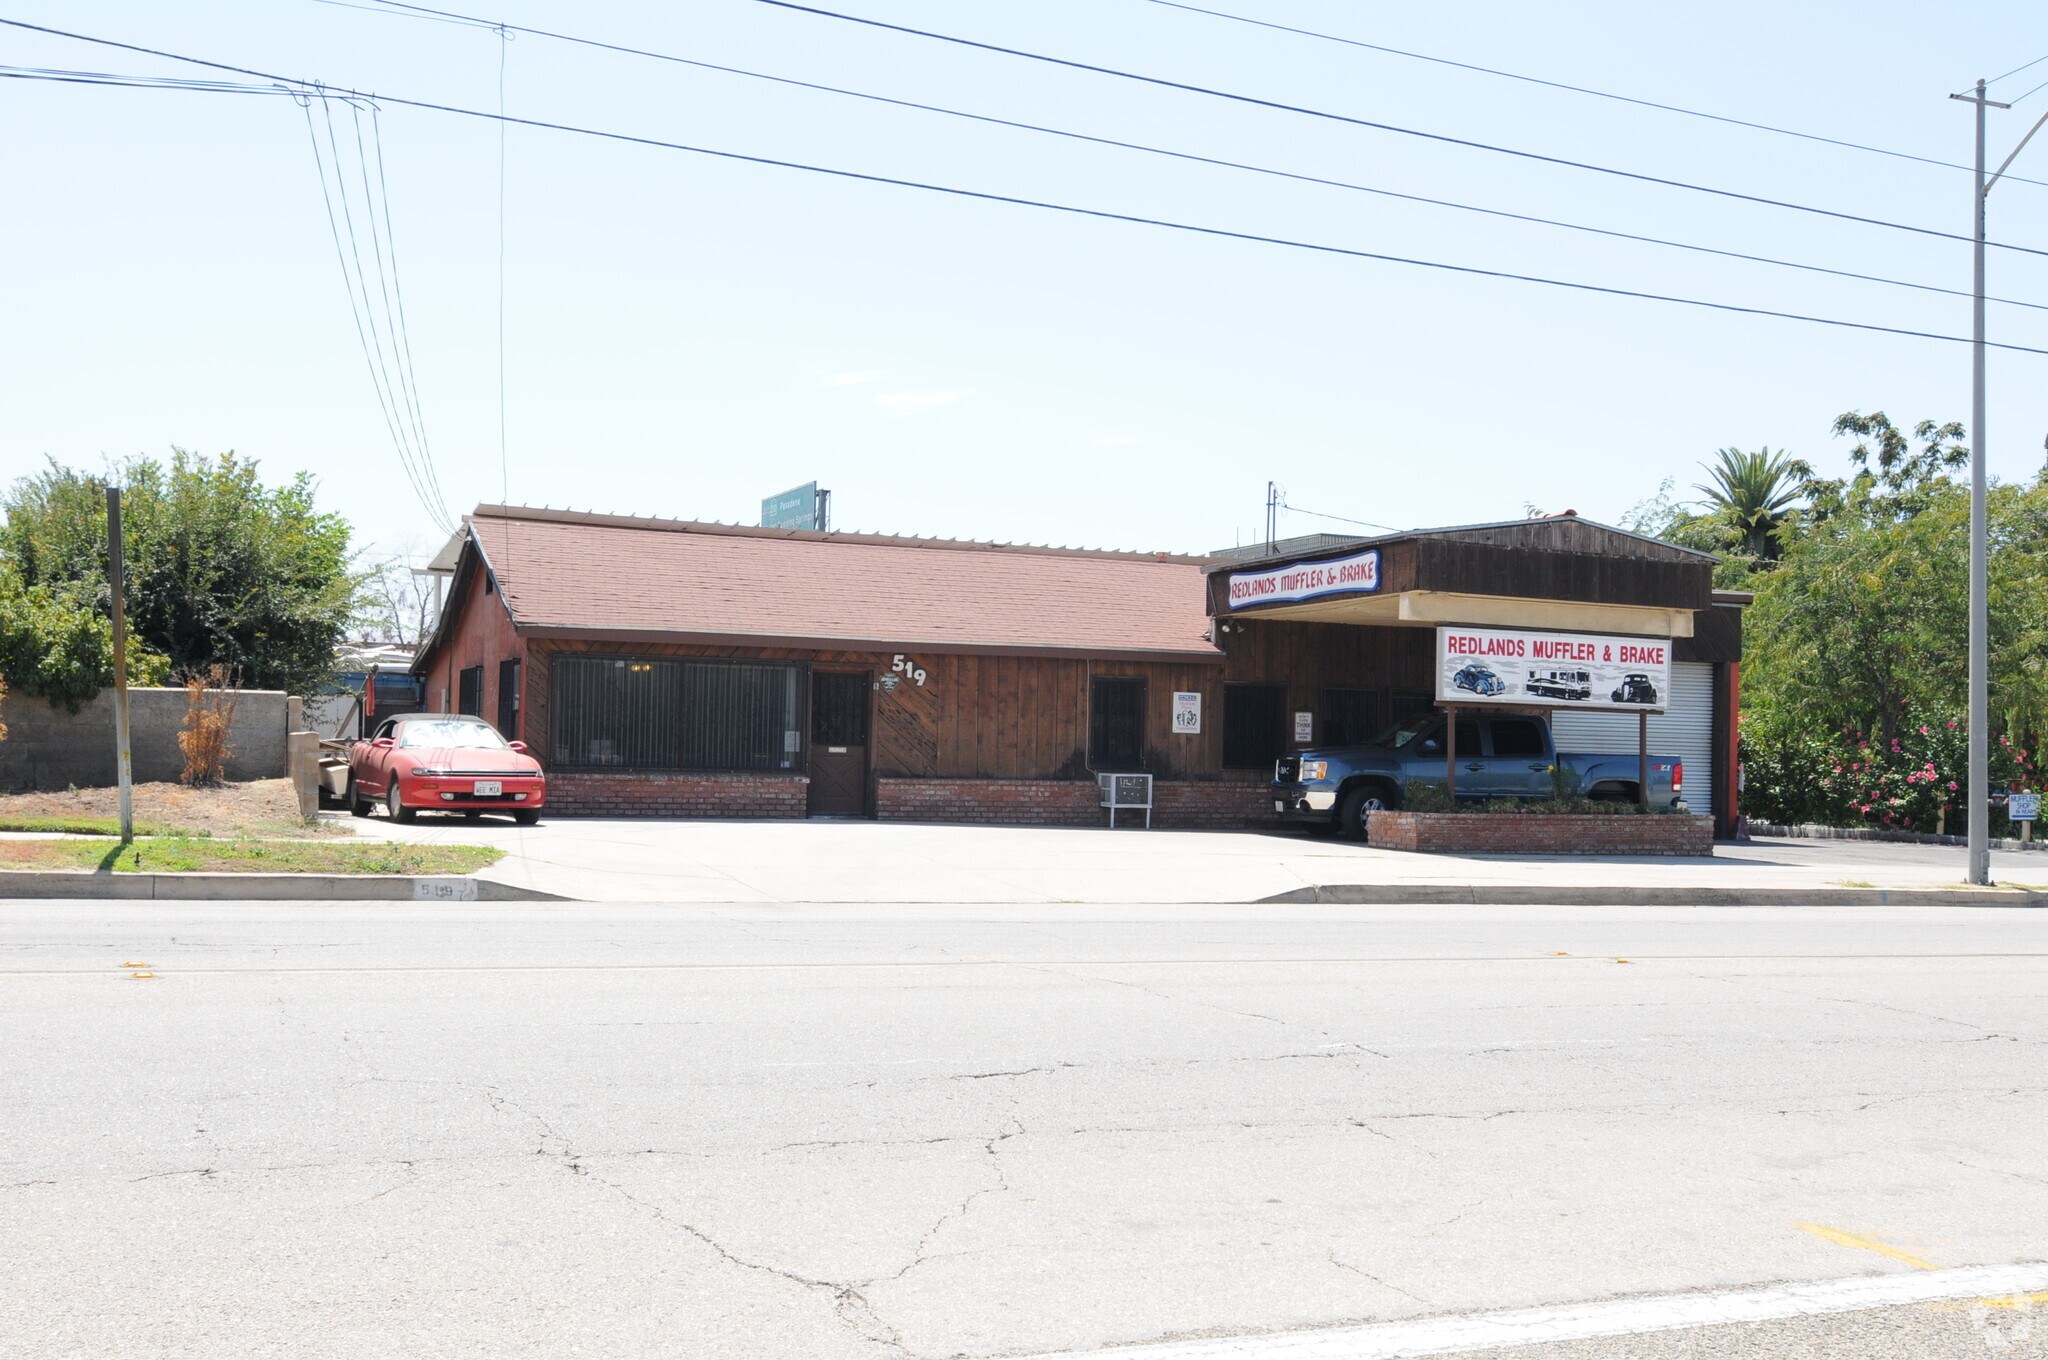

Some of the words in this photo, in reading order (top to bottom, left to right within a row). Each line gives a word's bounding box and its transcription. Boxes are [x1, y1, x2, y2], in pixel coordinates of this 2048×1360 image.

[780, 498, 800, 510] Pasadena
[1231, 577, 1276, 599] REDLANDS
[1281, 570, 1323, 592] MUFFLER
[1327, 567, 1337, 585] &
[1340, 561, 1374, 583] BRAKE
[1448, 636, 1525, 657] REDLANDS
[1533, 641, 1595, 661] MUFFLER
[1603, 645, 1612, 662] &
[1620, 646, 1664, 664] BRAKE
[892, 654, 926, 686] 519
